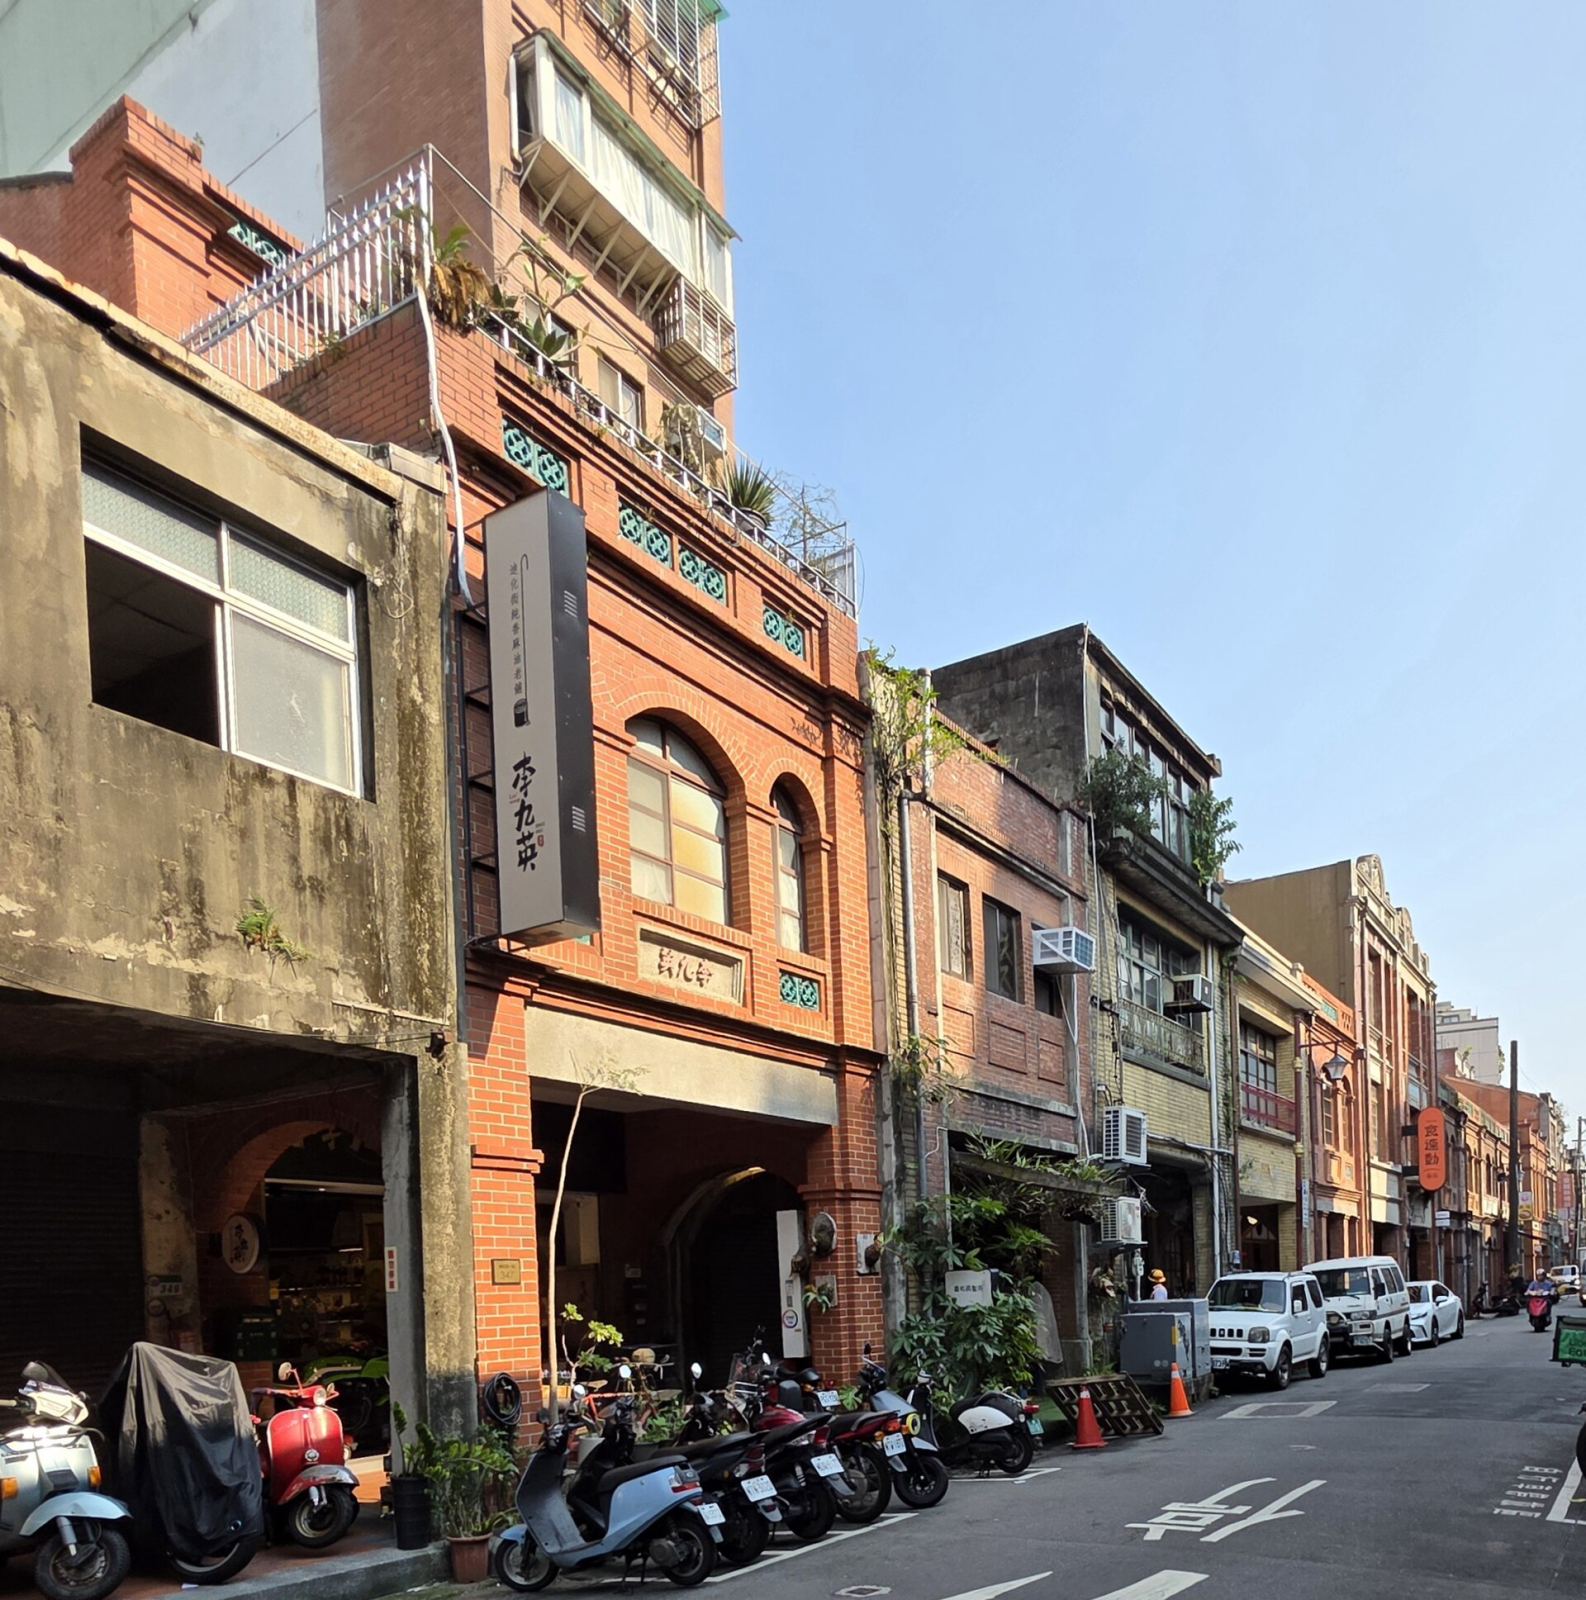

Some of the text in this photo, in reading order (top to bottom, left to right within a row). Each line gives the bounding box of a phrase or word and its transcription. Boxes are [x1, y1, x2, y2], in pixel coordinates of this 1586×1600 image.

[512, 750, 538, 872] 李九英
[1124, 1477, 1327, 1543] 停
